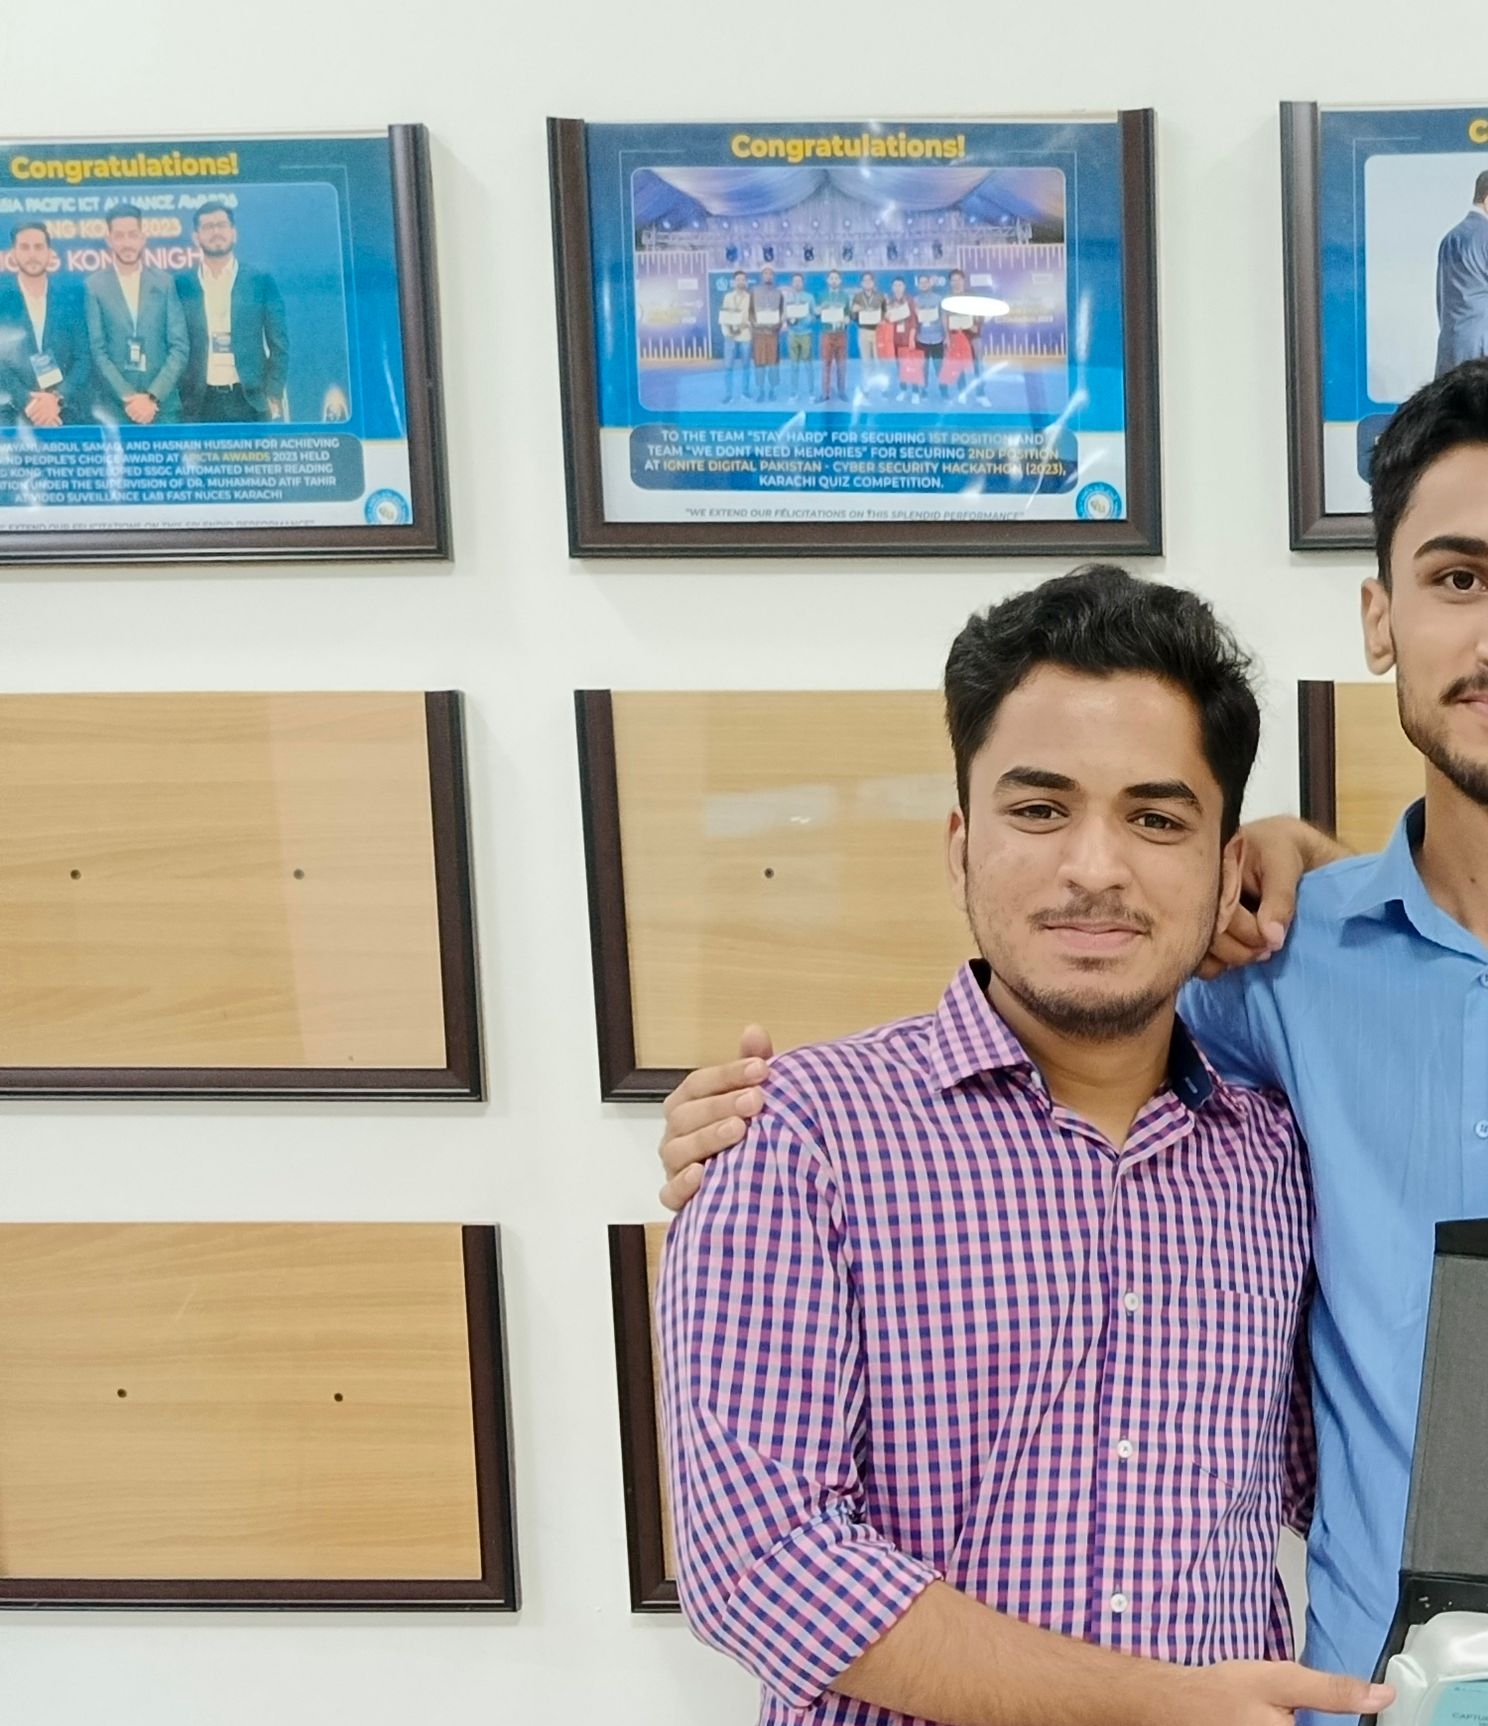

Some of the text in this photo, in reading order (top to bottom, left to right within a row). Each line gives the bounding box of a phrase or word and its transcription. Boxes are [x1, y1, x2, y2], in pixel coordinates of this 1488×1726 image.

[731, 130, 966, 163] Congratulations!
[11, 151, 240, 183] Congratulations!
[126, 441, 151, 451] AND
[152, 440, 201, 451] HASNAIN
[204, 439, 252, 450] HUSSAIN
[255, 439, 279, 449] FOR
[280, 438, 340, 449] ACHIEVING
[661, 430, 680, 442] TO
[682, 430, 707, 442] THE
[710, 430, 745, 442] TEAM
[748, 431, 782, 443] "STAY
[786, 431, 828, 443] HARD"
[831, 432, 858, 443] FOR
[861, 432, 926, 444] SECURING
[929, 432, 948, 444] 1ST
[1017, 433, 1045, 445] AND
[123, 453, 164, 464] AWARD
[166, 453, 180, 463] AT
[223, 452, 271, 462] AWARDS
[273, 451, 299, 462] 2023
[300, 451, 330, 462] HELD
[648, 445, 1059, 461] TEAM "WE DONT NEED MEMORIES" FOR SECURING 2ND POSITION
[46, 467, 74, 477] THEY
[175, 464, 242, 475] AUTOMATED
[244, 464, 283, 475] METER
[284, 463, 334, 474] READING
[644, 459, 1067, 476] AT IGNITE DIGITAL PAKISTAN CYBER SECURITY HACKATHON (2023),
[71, 480, 93, 490] THE
[169, 478, 184, 489] OF
[207, 477, 276, 488] MUHAMMAD
[278, 477, 302, 487] ATIF
[304, 476, 337, 487] TAHIR
[759, 475, 944, 489] KARACHI QUIZ COMPETITION.
[142, 491, 165, 502] LAB
[166, 491, 192, 501] FAST
[195, 490, 232, 500] NUCES
[234, 490, 283, 500] KARACHI
[709, 508, 748, 518] EXTEND
[750, 508, 772, 518] OUR
[849, 510, 866, 519] ON
[867, 510, 889, 520] THIS
